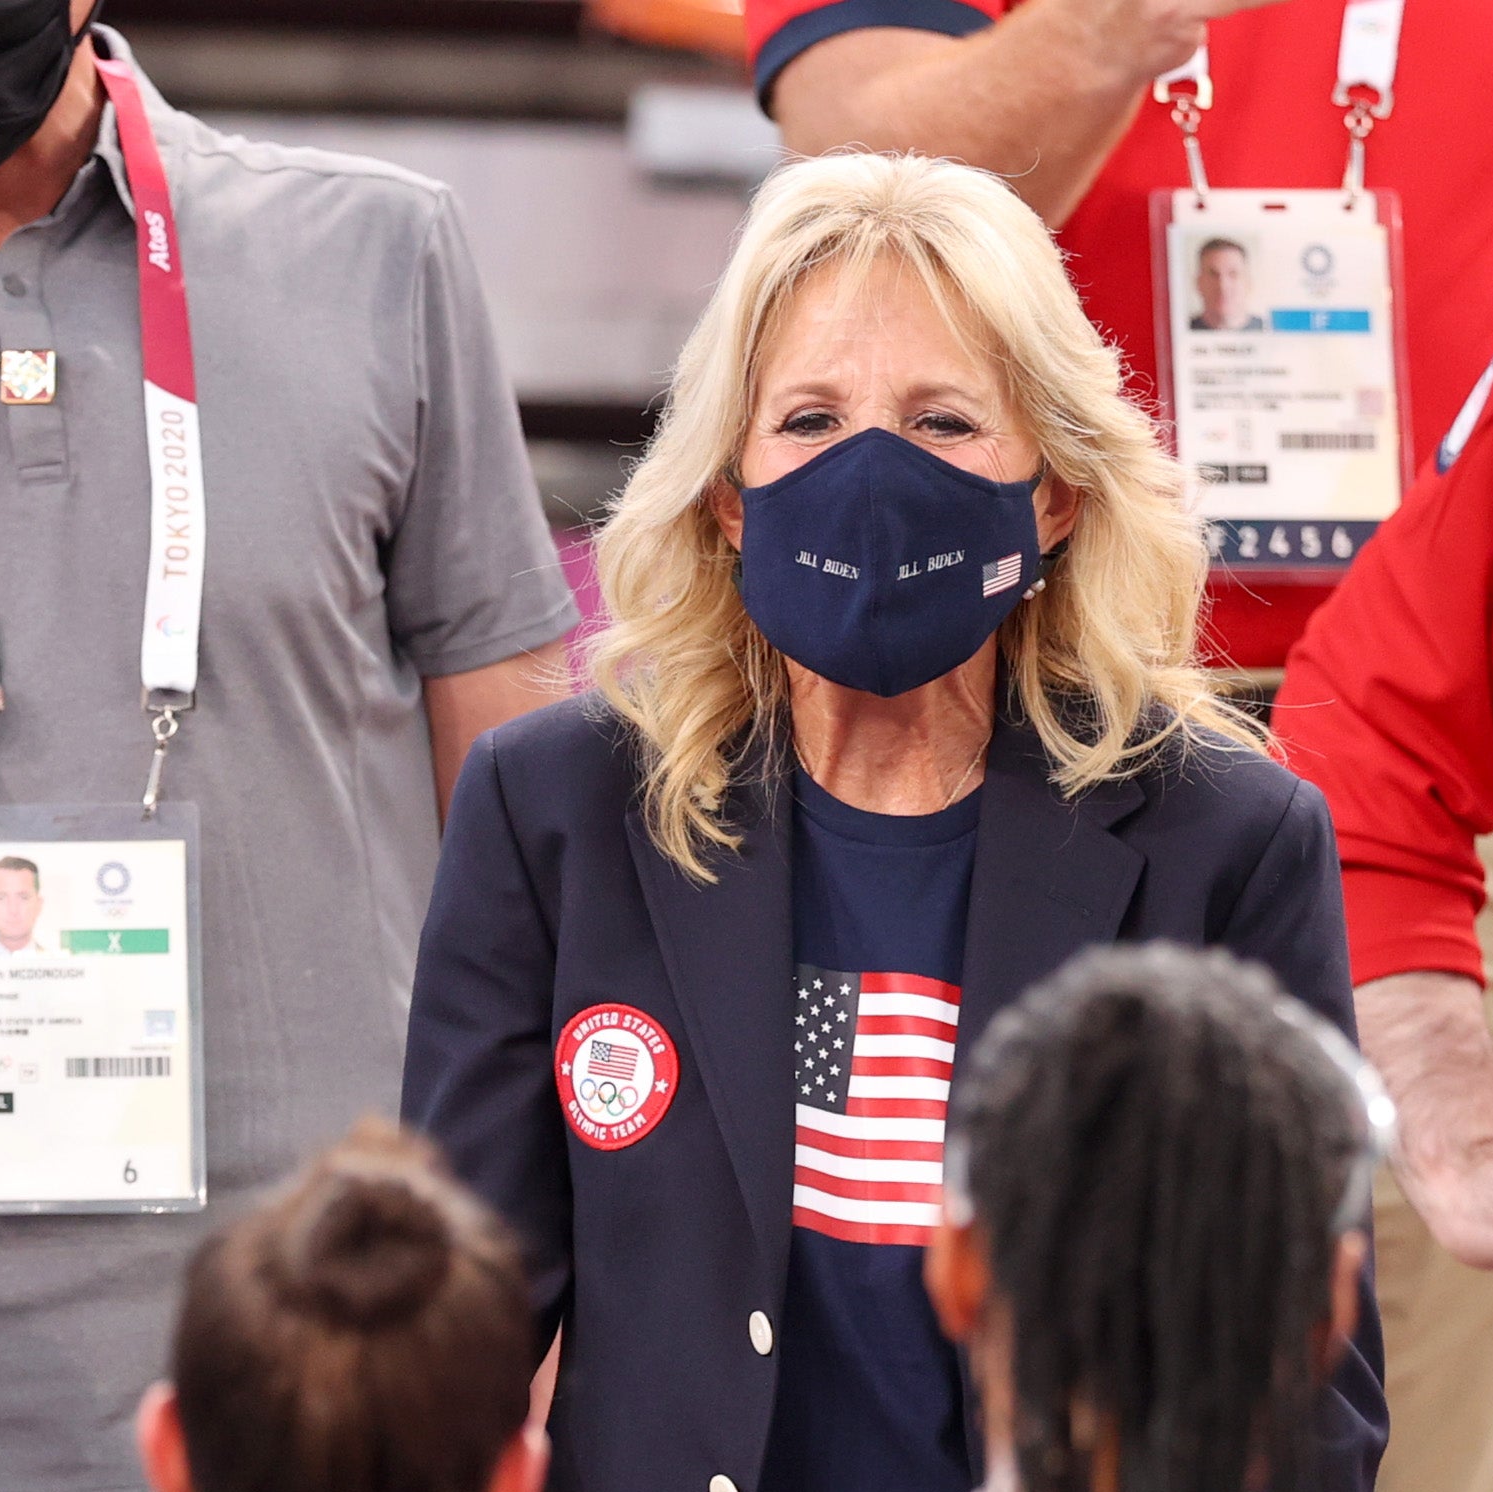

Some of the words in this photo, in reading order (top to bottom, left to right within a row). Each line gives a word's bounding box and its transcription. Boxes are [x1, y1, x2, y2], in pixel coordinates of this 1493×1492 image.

[165, 409, 185, 480] 2020
[163, 486, 191, 580] TOKYO
[1238, 525, 1259, 559] 2
[795, 550, 818, 569] JILL
[822, 558, 861, 580] BIDEN
[896, 561, 923, 581] JILL
[927, 549, 966, 572] BIDEN
[572, 1012, 619, 1041] UNITED
[622, 1014, 666, 1055] STATES
[568, 1100, 607, 1140] OLYMPIC
[610, 1113, 647, 1139] TEAM
[123, 1158, 138, 1184] 6
